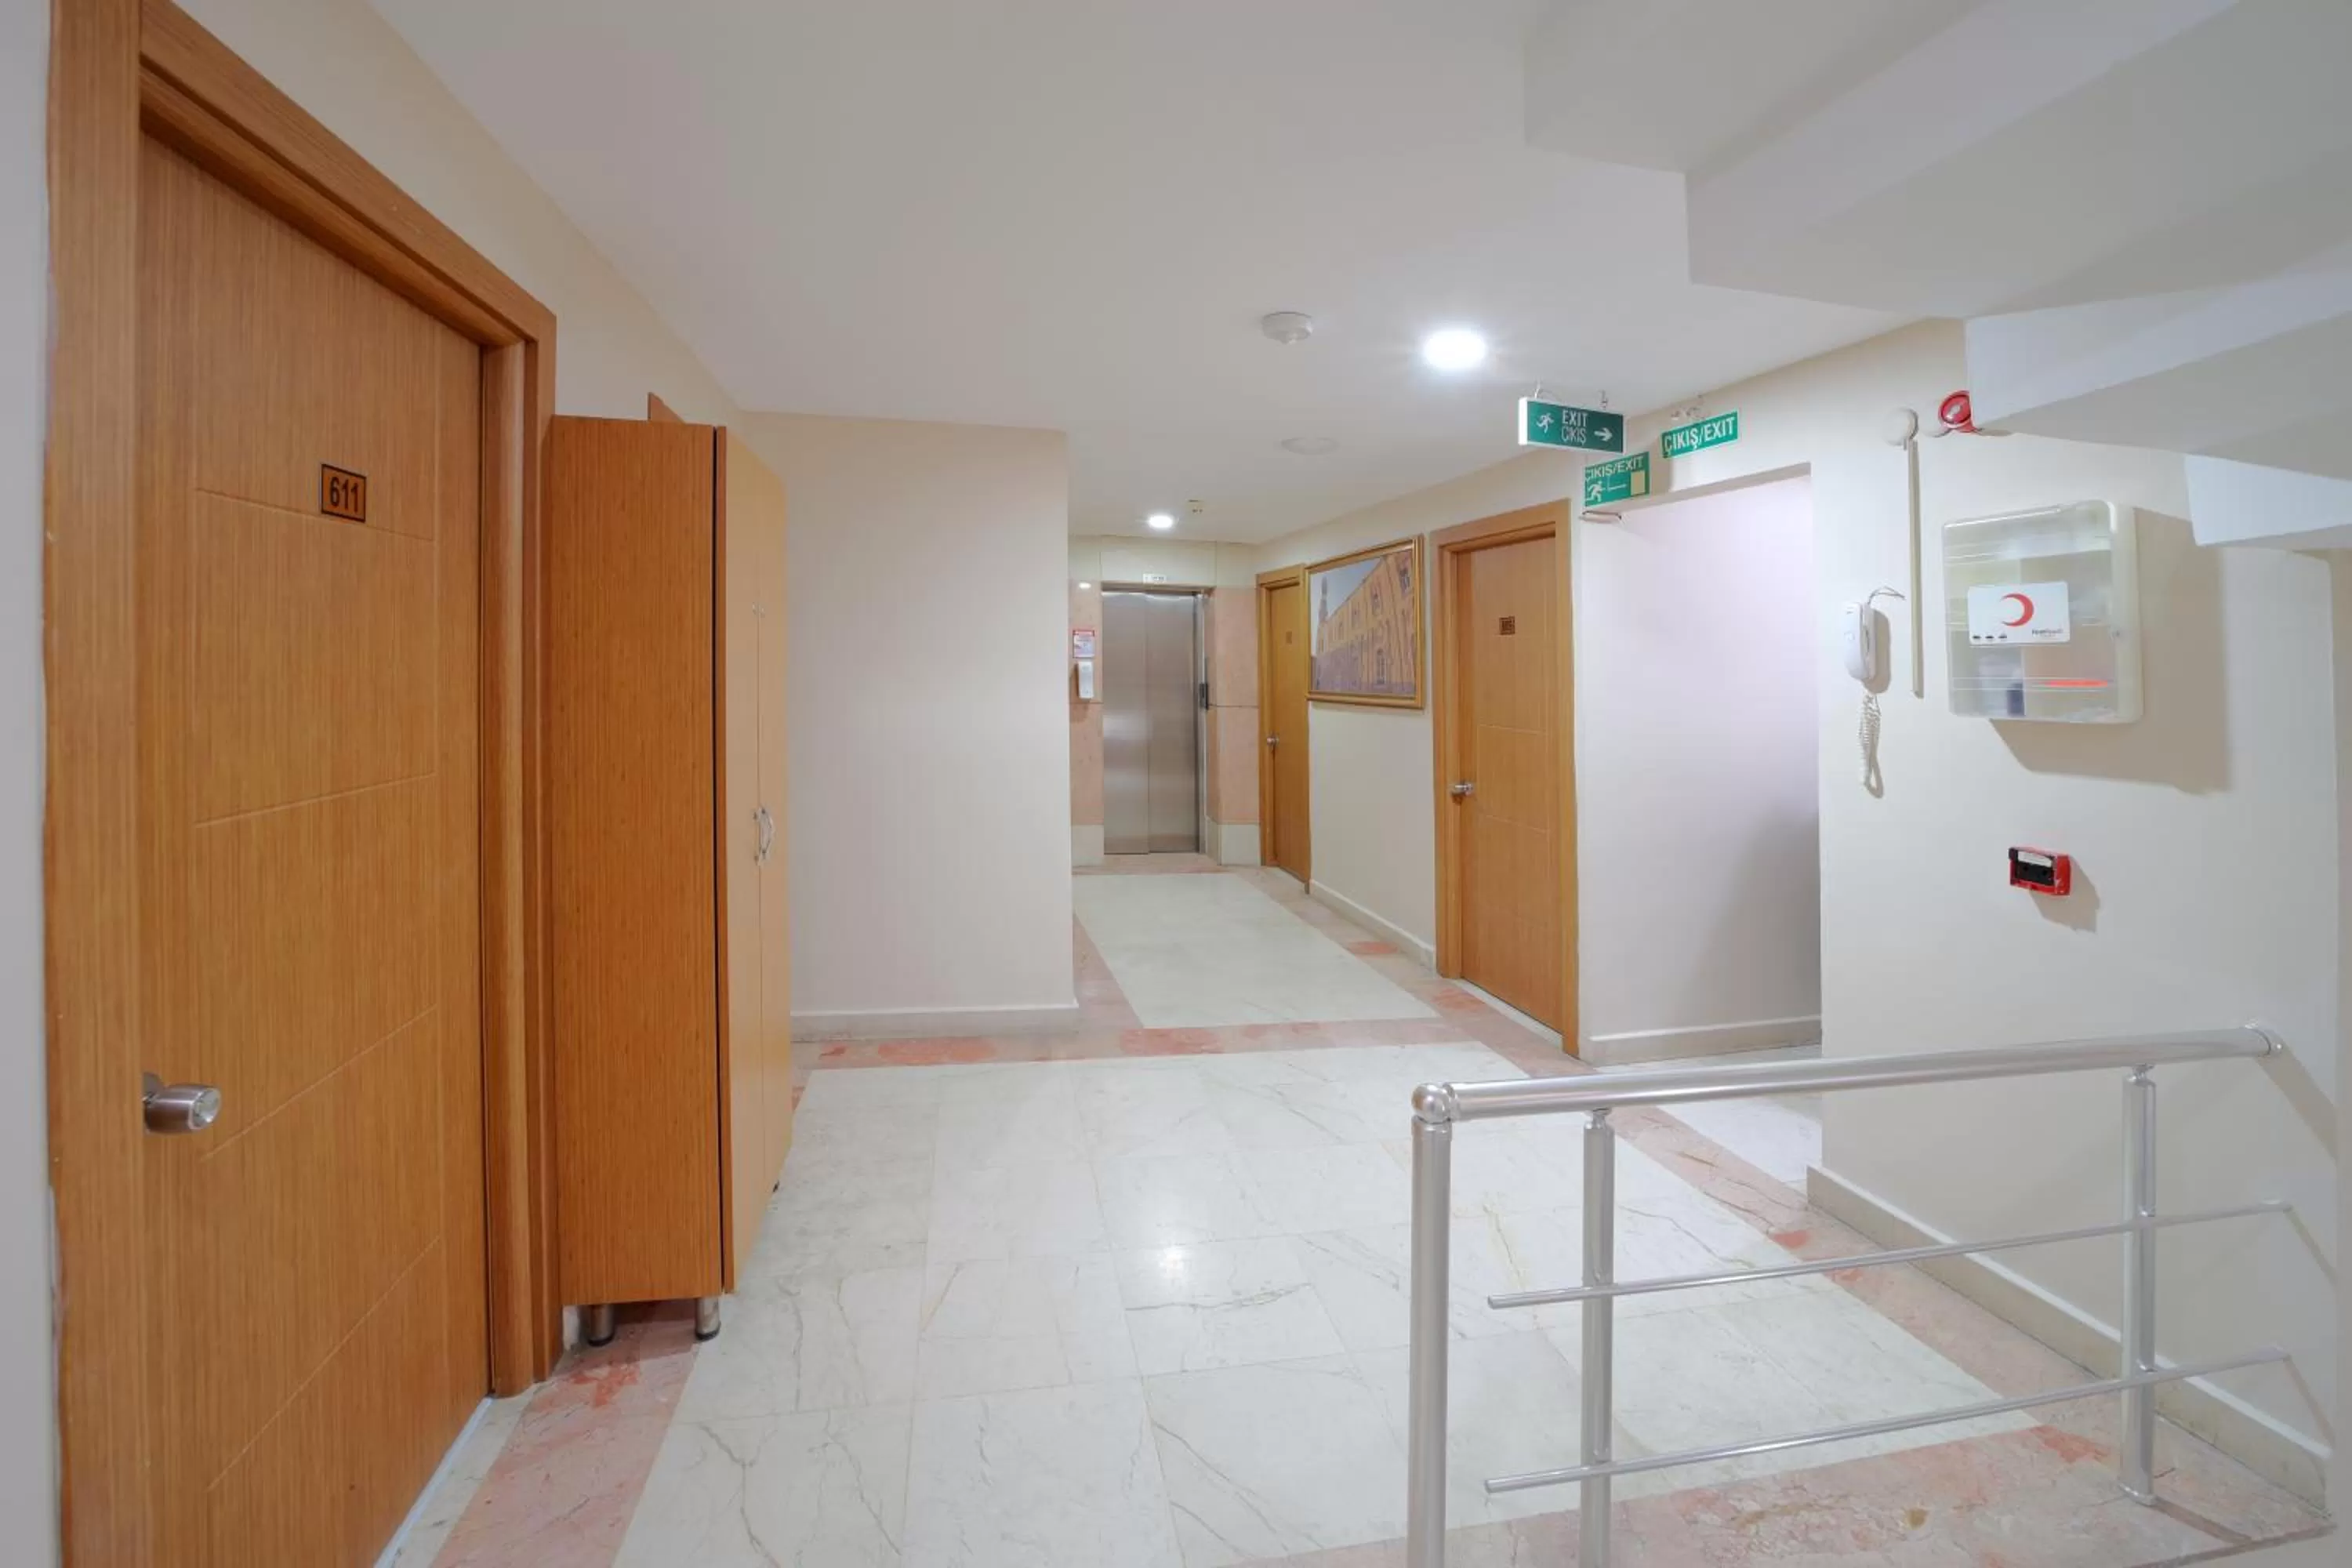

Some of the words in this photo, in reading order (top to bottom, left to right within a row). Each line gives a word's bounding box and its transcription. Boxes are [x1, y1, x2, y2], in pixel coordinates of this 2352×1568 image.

[1562, 409, 1588, 427] EXIT
[1664, 416, 1735, 455] ÇIKIŞ/EXIT
[330, 475, 358, 514] 611
